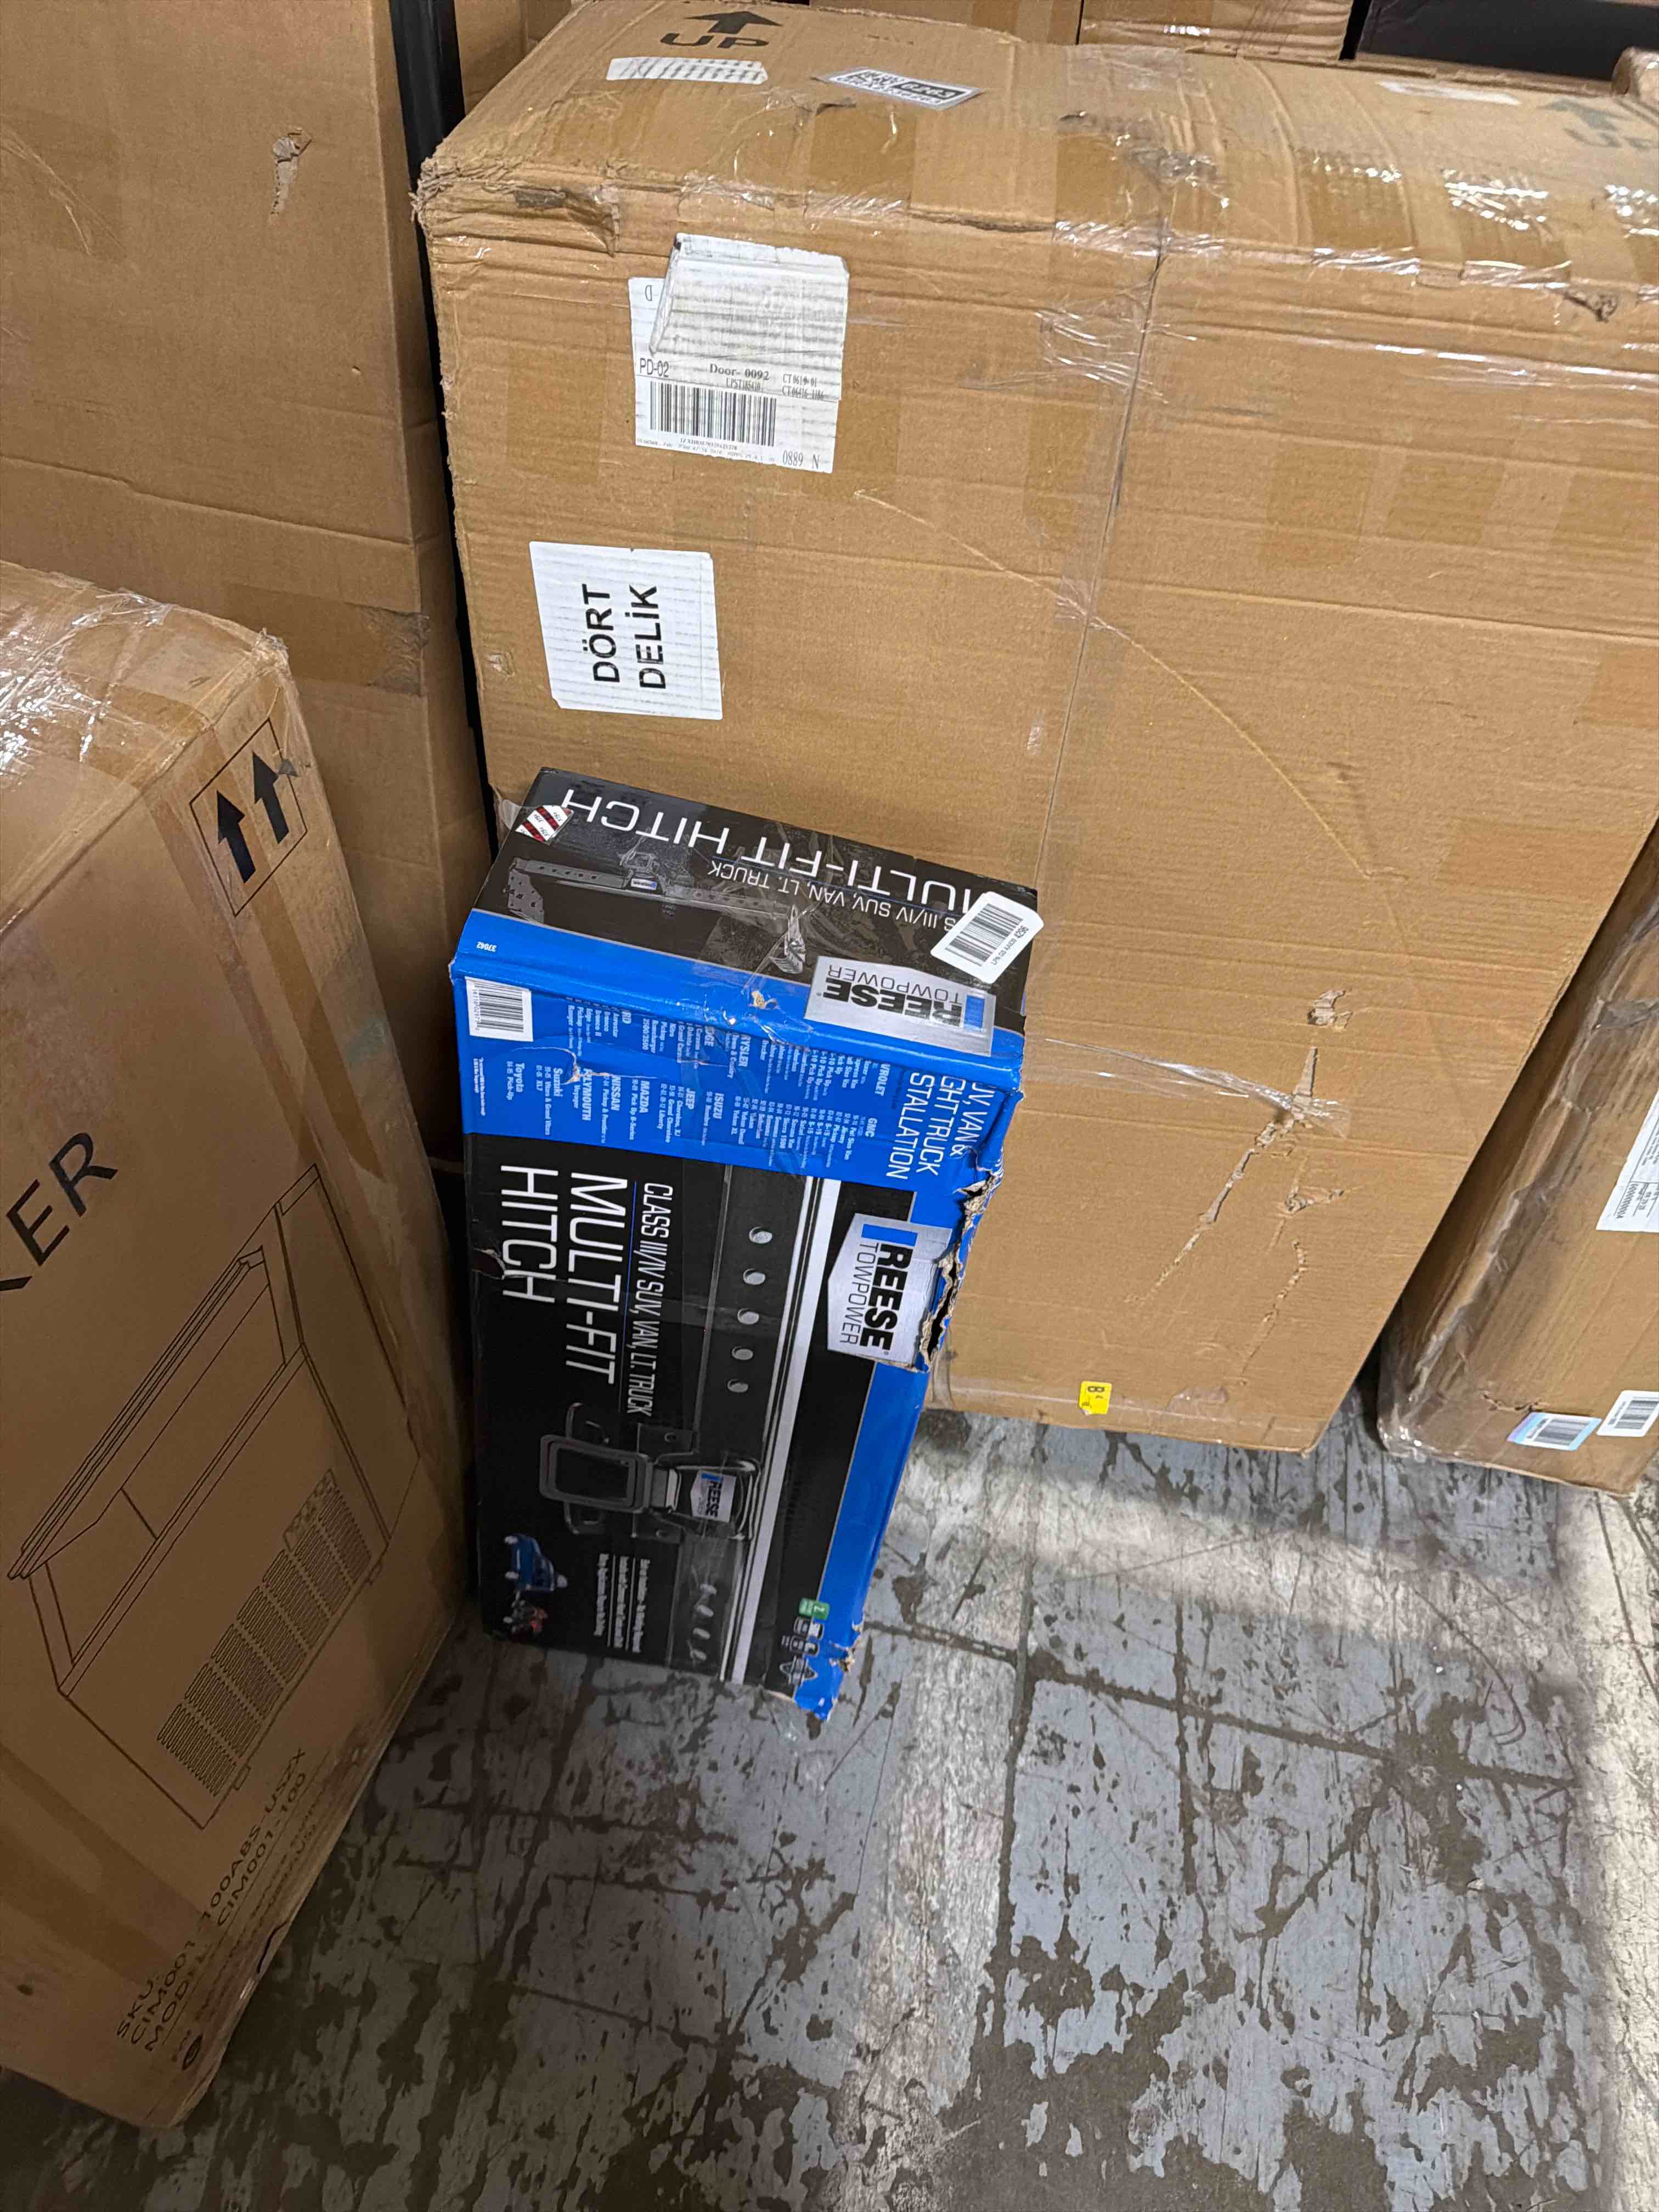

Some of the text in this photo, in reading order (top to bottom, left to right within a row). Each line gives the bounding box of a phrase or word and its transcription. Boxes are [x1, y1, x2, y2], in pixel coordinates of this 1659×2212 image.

[659, 32, 770, 49] UP
[640, 358, 669, 378] PD-02
[745, 368, 770, 380] 0092
[782, 450, 804, 466] 0889
[812, 454, 820, 469] N
[582, 583, 620, 683] DÖRT
[624, 584, 666, 689] DELİK
[561, 789, 730, 854] HITCH
[707, 860, 770, 889] TRUCK
[806, 881, 845, 908] VAN,
[852, 894, 892, 918] SUV,
[828, 965, 961, 1003] TOWPOWER
[566, 1005, 575, 1026] Ranger
[576, 1006, 584, 1027] Pickup
[823, 978, 963, 1028] REESE
[659, 1021, 668, 1041] Pickup
[738, 1035, 751, 1066] RYSLER
[514, 1063, 524, 1092] Toyota
[553, 1068, 563, 1097] Suzuki
[808, 1064, 817, 1075] Pick
[817, 1065, 826, 1076] Pick
[826, 1066, 834, 1078] Pick
[874, 1063, 890, 1097] VROLET
[572, 1085, 580, 1109] Voyager
[601, 1088, 610, 1107] Pickup
[611, 1076, 621, 1111] NISSAN
[639, 1080, 650, 1113] MAZDA
[685, 1088, 696, 1109] JEEP
[713, 1093, 724, 1119] ISUZU
[629, 1107, 637, 1115] Up
[657, 1109, 666, 1129] Liberty
[865, 1118, 878, 1138] GMC
[886, 1072, 935, 1180] STALLATION
[916, 1076, 966, 1176] GHT TRUCK
[954, 1111, 988, 1142] VAN
[950, 1144, 973, 1157] &
[0, 1132, 119, 1291] ER
[500, 1165, 558, 1304] HITCH
[566, 1172, 629, 1385] MULTI-FIT
[839, 1241, 880, 1345] TOWPOWER
[626, 1183, 674, 1417] CLASS III/IV SUV, VAN, LT. TRUCK
[860, 1243, 912, 1351] REESE
[704, 1482, 723, 1518] REESE
[217, 1773, 306, 1926] CIM001-100
[116, 1973, 160, 2037] SKU:
